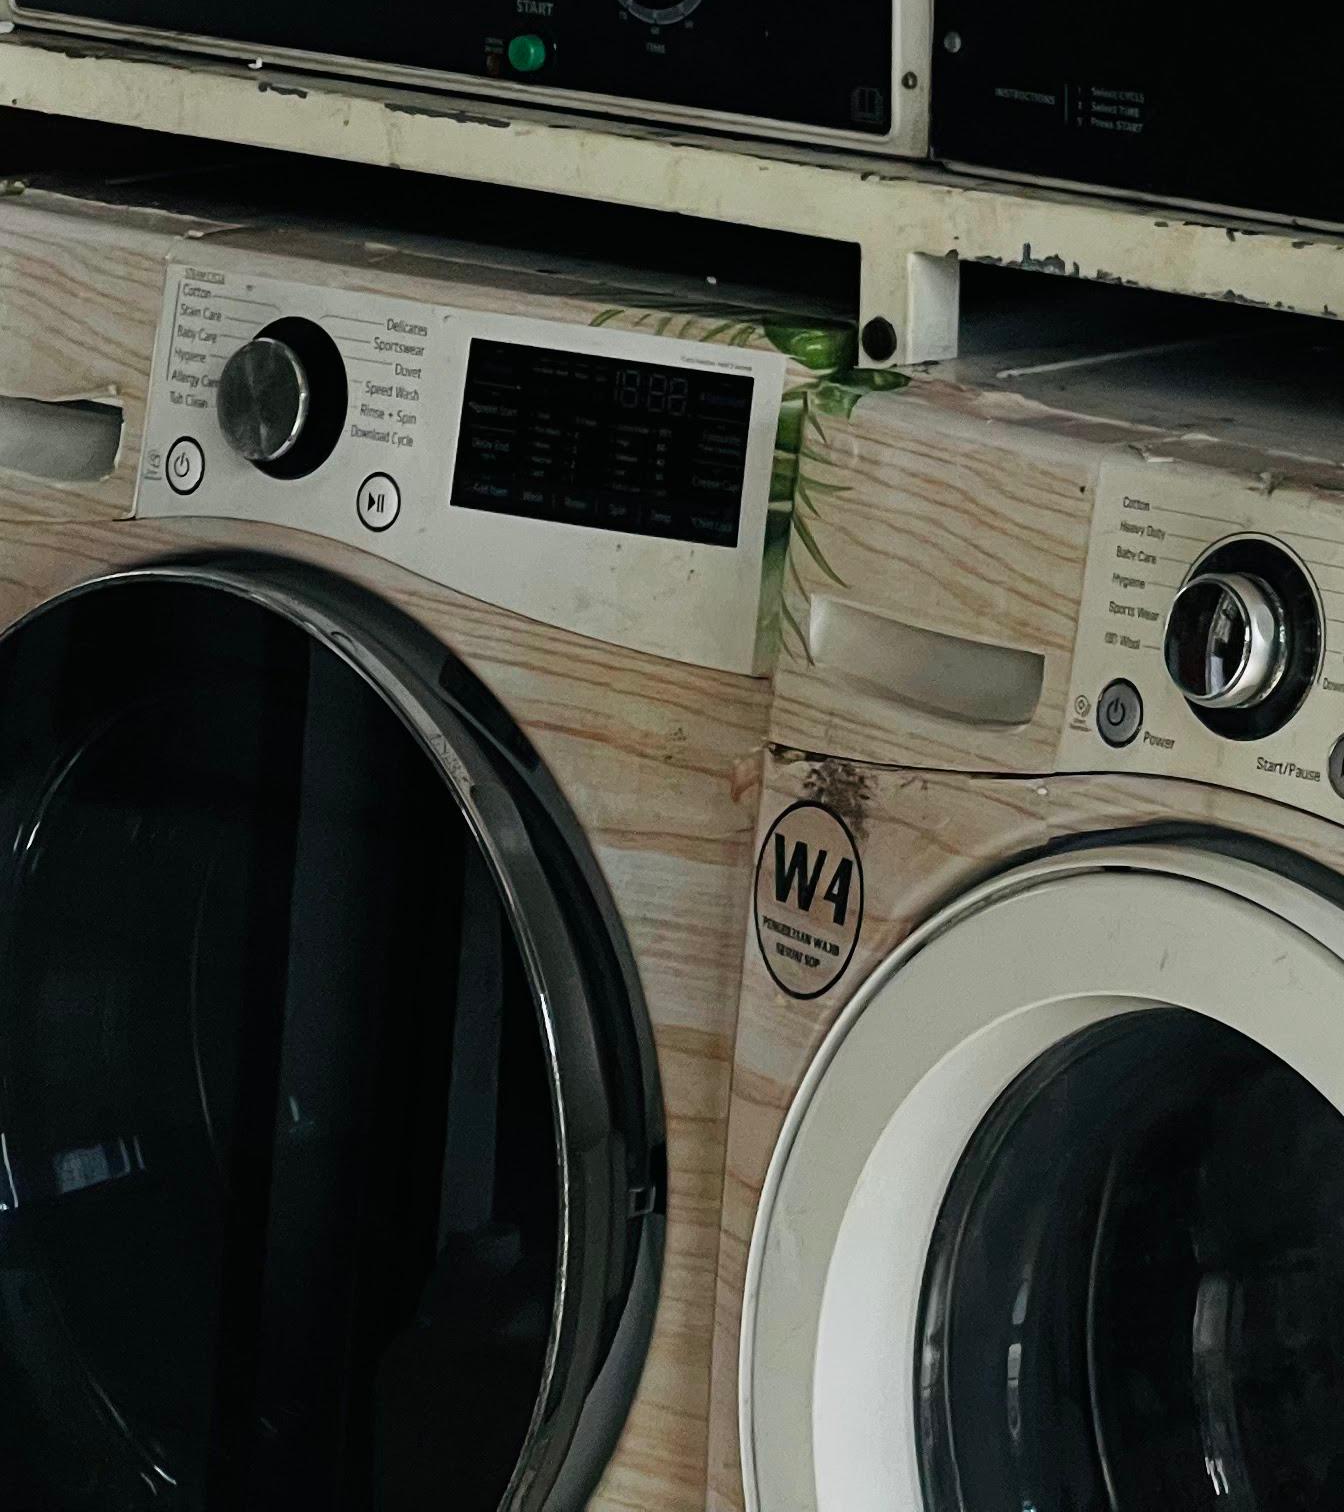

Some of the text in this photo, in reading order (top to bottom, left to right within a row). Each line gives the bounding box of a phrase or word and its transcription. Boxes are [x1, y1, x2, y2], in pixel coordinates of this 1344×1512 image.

[387, 318, 428, 337] Delicates
[374, 336, 425, 357] Sportswear
[395, 362, 422, 380] Duvet
[365, 380, 393, 398] Speed
[396, 409, 417, 426] Spin
[1143, 730, 1176, 750] Power
[1256, 756, 1321, 782] Start/Pause
[774, 833, 854, 926] W4
